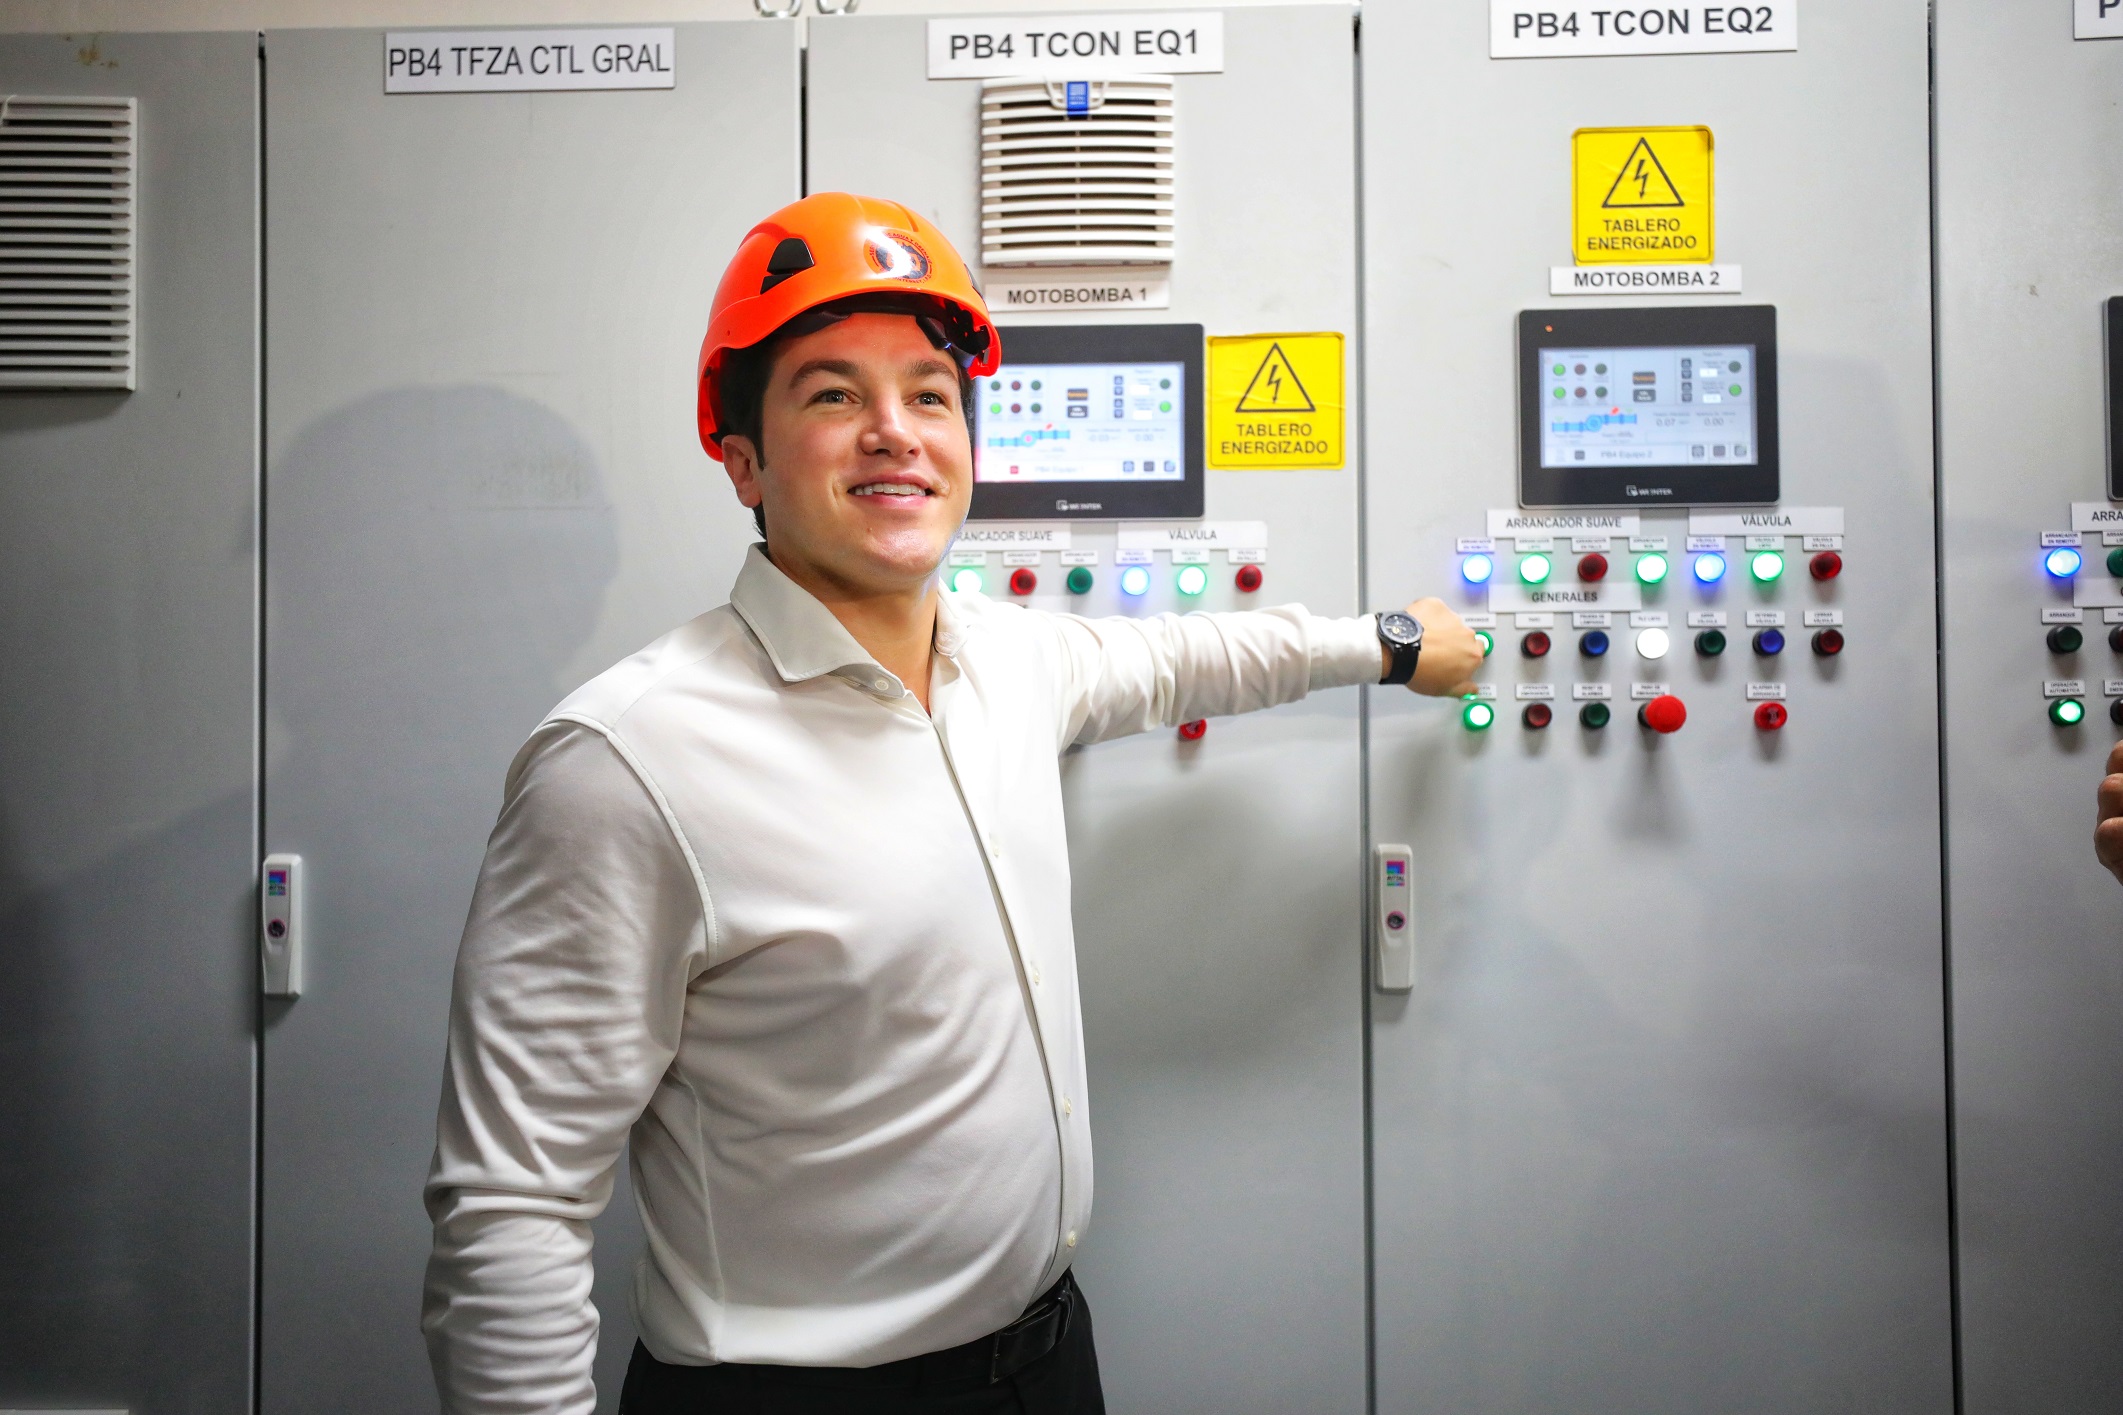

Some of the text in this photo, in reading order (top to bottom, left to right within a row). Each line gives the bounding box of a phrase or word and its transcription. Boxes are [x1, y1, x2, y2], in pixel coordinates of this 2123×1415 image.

[1514, 6, 1772, 38] PB4 TCON EQ2
[950, 29, 1197, 60] PB4 TCON EQ1
[389, 44, 671, 77] PB4 TFZA CTL GRAL
[1603, 218, 1680, 232] TABLERO
[1587, 236, 1697, 250] ENERGIZADO
[1574, 271, 1720, 287] MOTOBOMBA 2
[1008, 287, 1147, 304] MOTOBOMBA 1
[1236, 423, 1312, 437] TABLERO
[1221, 440, 1329, 454] ENERGIZADO
[1506, 517, 1622, 528] ARRANCADOR SUAVE
[1742, 514, 1792, 527] VÁLVULA
[956, 530, 1053, 541] RANCADOR SUAVE
[1169, 528, 1217, 540] VÁLVULA
[1532, 591, 1598, 603] GENERALES
